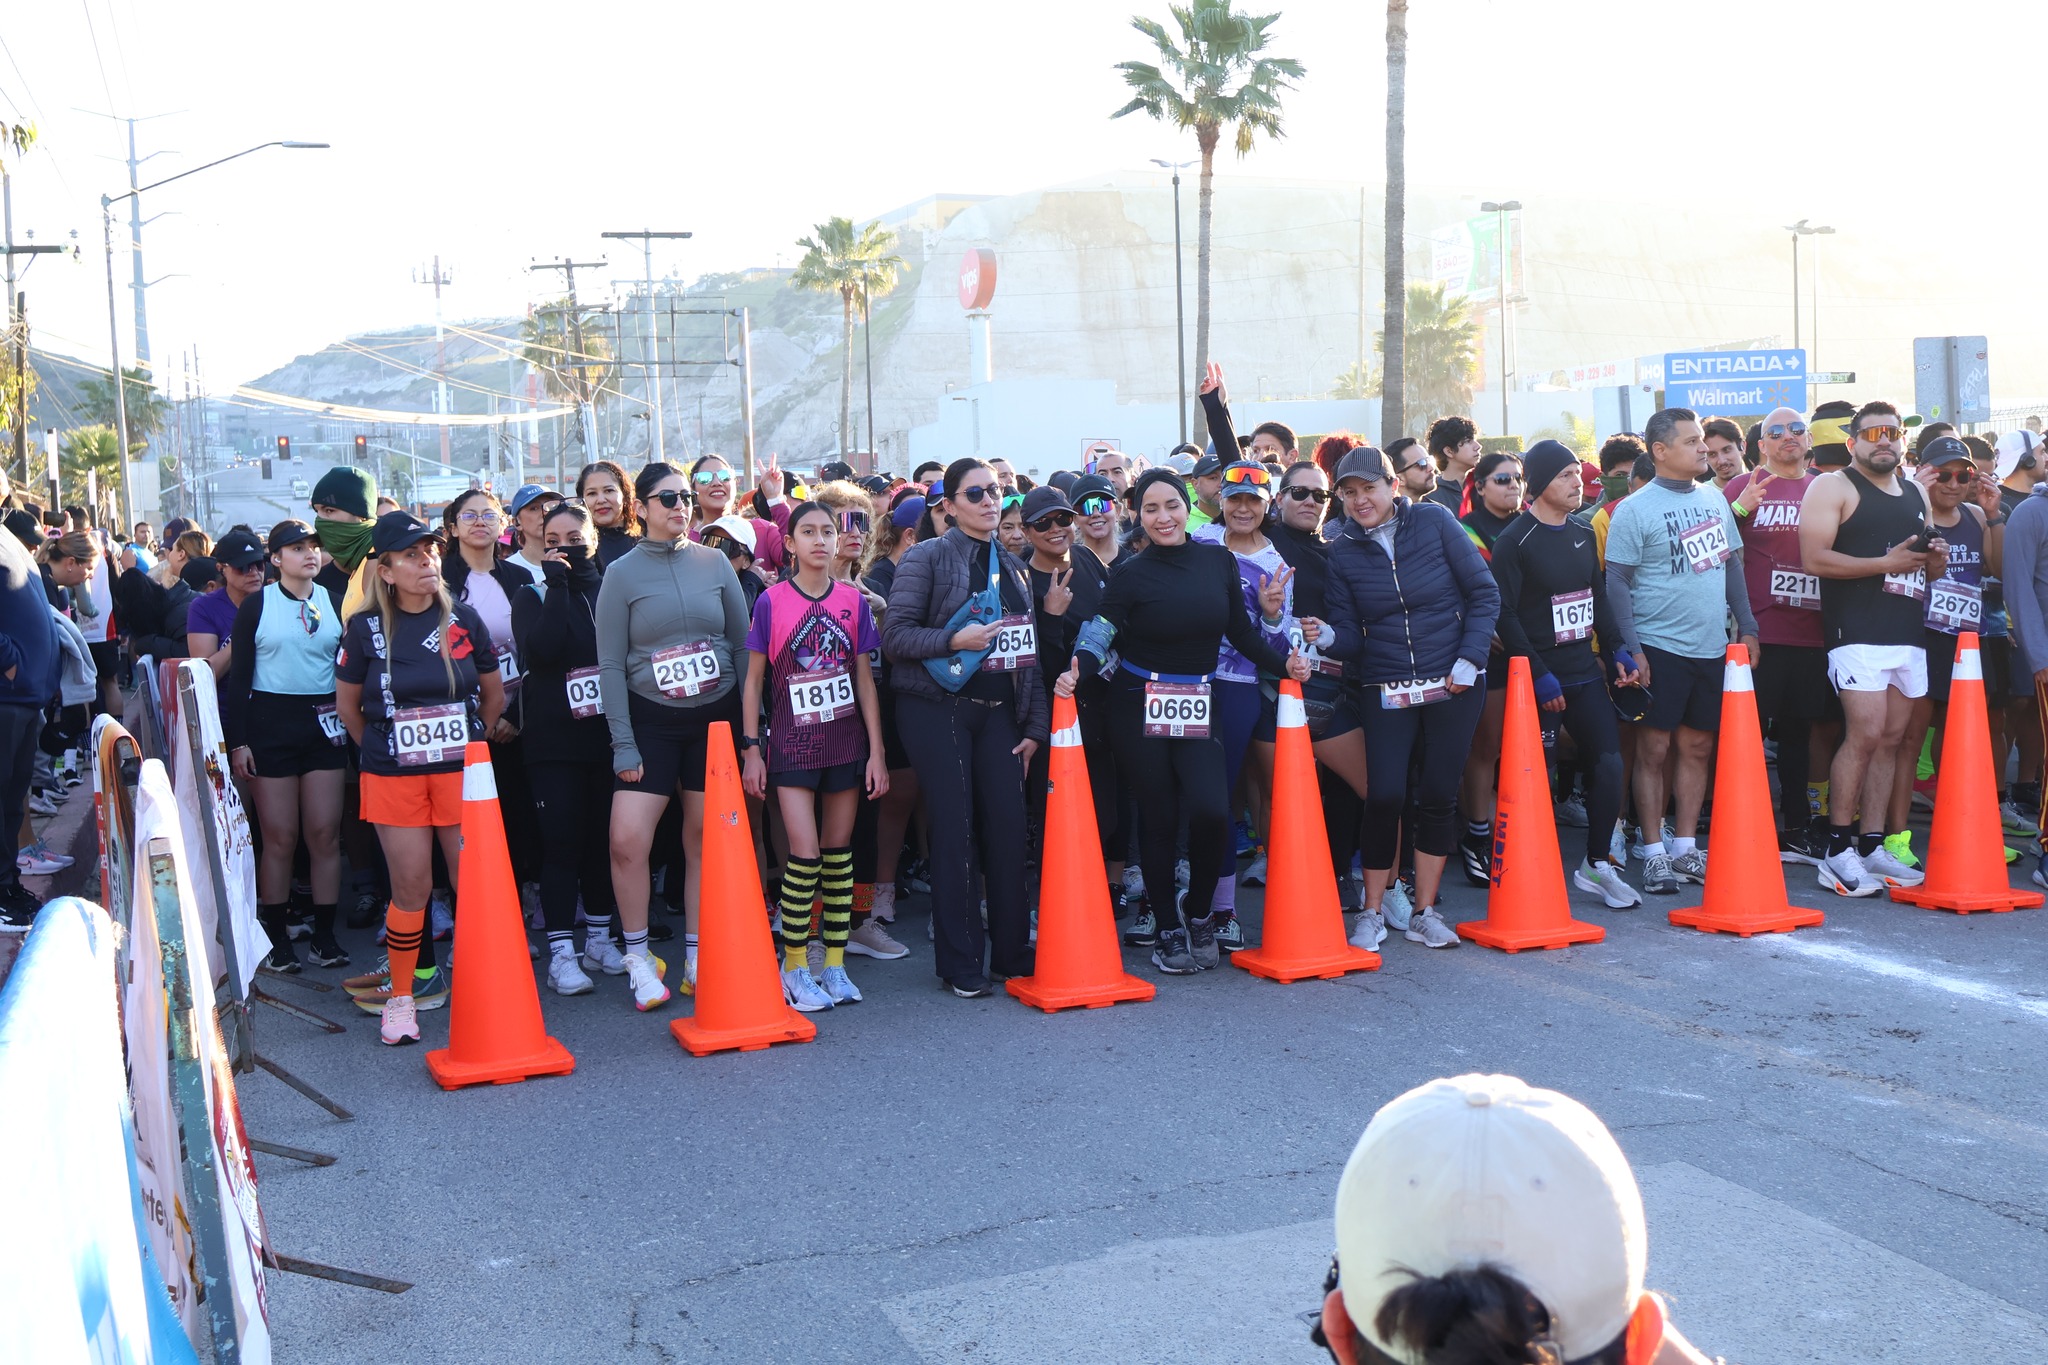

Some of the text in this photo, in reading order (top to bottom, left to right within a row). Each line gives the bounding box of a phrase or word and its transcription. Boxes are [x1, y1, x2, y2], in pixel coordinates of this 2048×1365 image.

[1640, 363, 1665, 383] IHO
[1672, 355, 1784, 375] ENTRADA
[1687, 387, 1763, 407] Walmart
[1687, 528, 1726, 559] 0124
[1945, 551, 1980, 564] ALLE
[1774, 574, 1818, 595] 2211
[1556, 601, 1593, 627] 1675
[1933, 593, 1980, 619] 2679
[790, 616, 851, 651] RUNNING ACADEMIA
[991, 629, 1033, 653] 654
[657, 655, 716, 686] 2819
[570, 679, 600, 703] 03
[794, 678, 851, 709] 1815
[1148, 697, 1207, 721] 0669
[399, 719, 464, 748] 0848
